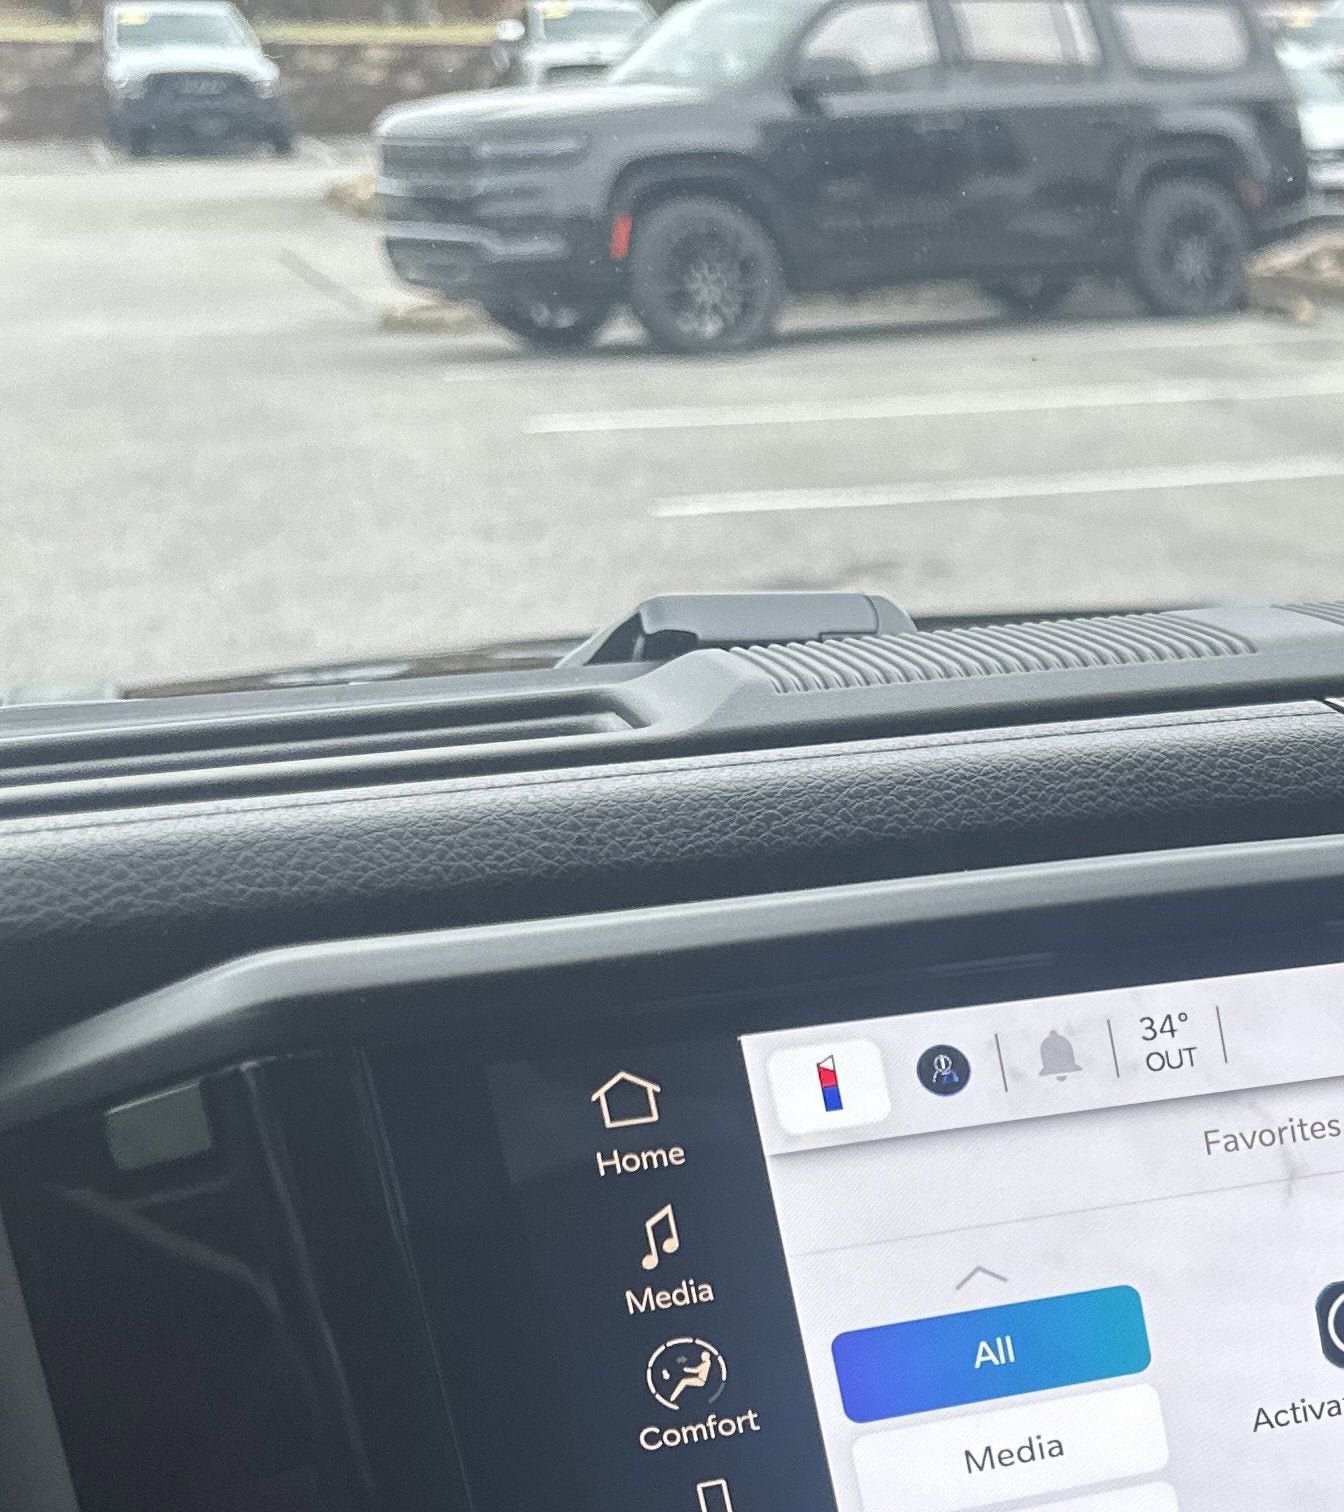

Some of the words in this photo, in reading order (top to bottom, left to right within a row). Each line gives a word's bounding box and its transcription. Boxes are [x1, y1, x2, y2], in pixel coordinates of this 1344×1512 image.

[1140, 1012, 1188, 1042] 34°
[1146, 1047, 1197, 1072] OUT
[1204, 1117, 1342, 1155] Favorites
[596, 1144, 686, 1177] Home
[625, 1279, 715, 1315] Media
[974, 1335, 1016, 1369] All
[639, 1409, 761, 1451] Comfort
[964, 1434, 1065, 1474] Media
